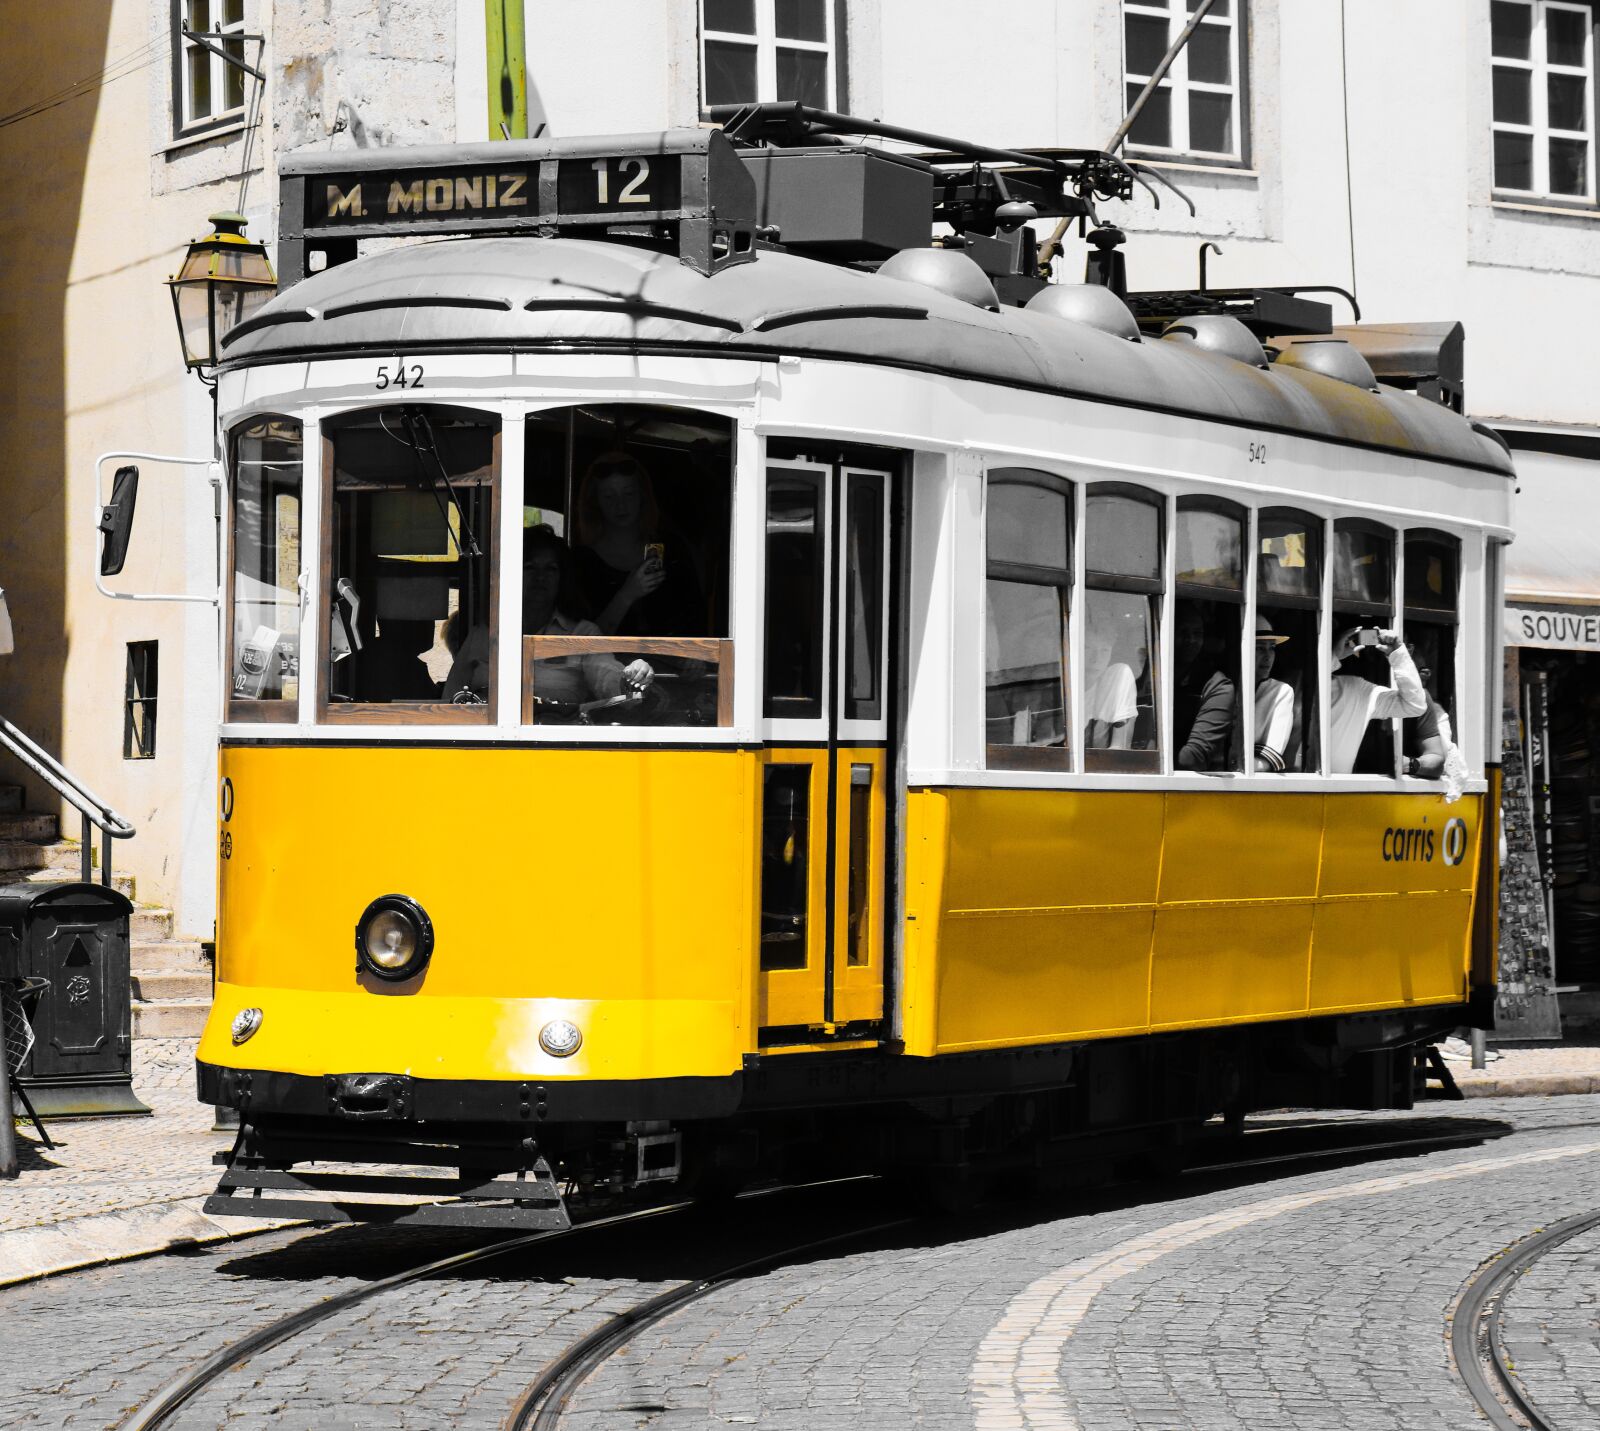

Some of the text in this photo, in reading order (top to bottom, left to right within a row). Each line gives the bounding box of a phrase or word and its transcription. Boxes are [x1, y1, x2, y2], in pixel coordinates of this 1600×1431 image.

[327, 173, 528, 217] M. MONIZ
[591, 156, 650, 204] 12
[375, 364, 424, 390] 542
[1249, 442, 1266, 464] 542
[1521, 615, 1600, 643] SOUVE
[1382, 815, 1434, 862] carris
